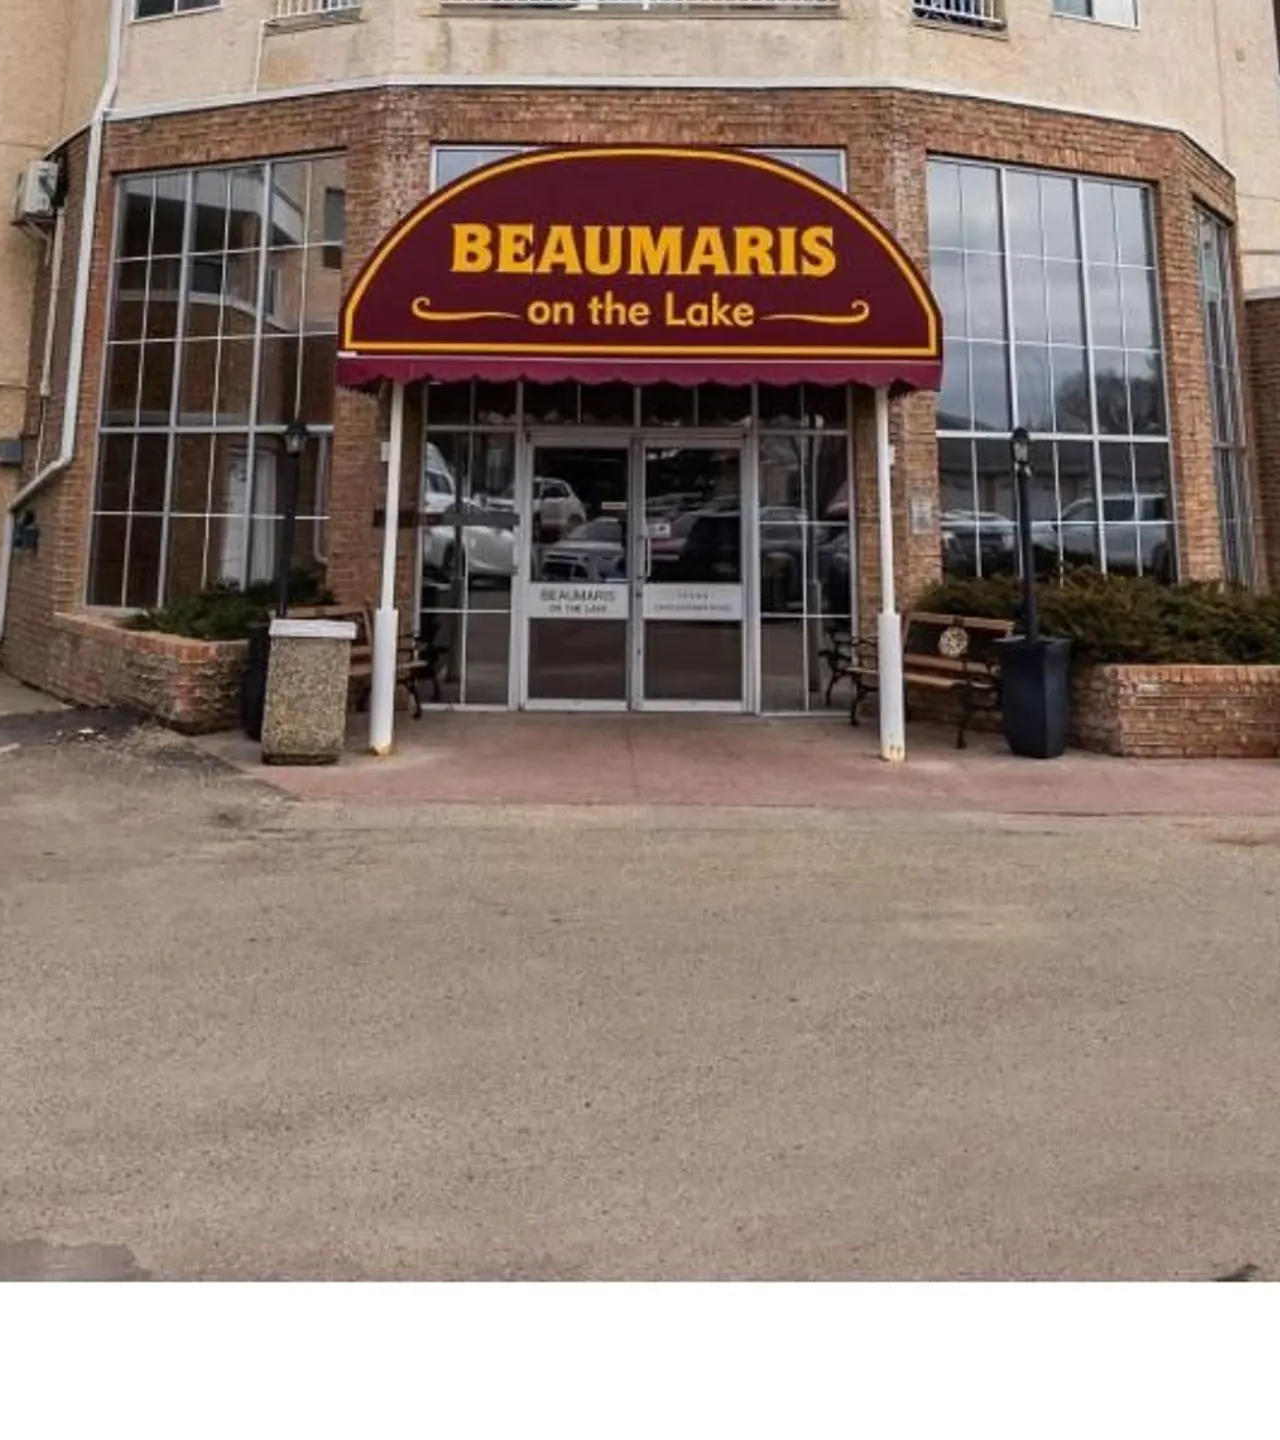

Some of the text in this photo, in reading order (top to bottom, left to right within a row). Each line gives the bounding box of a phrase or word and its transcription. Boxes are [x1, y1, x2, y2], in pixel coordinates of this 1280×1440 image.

[450, 223, 837, 277] BEAUMARIS
[527, 290, 755, 327] on the Lake
[541, 589, 615, 602] BEAUMARIS
